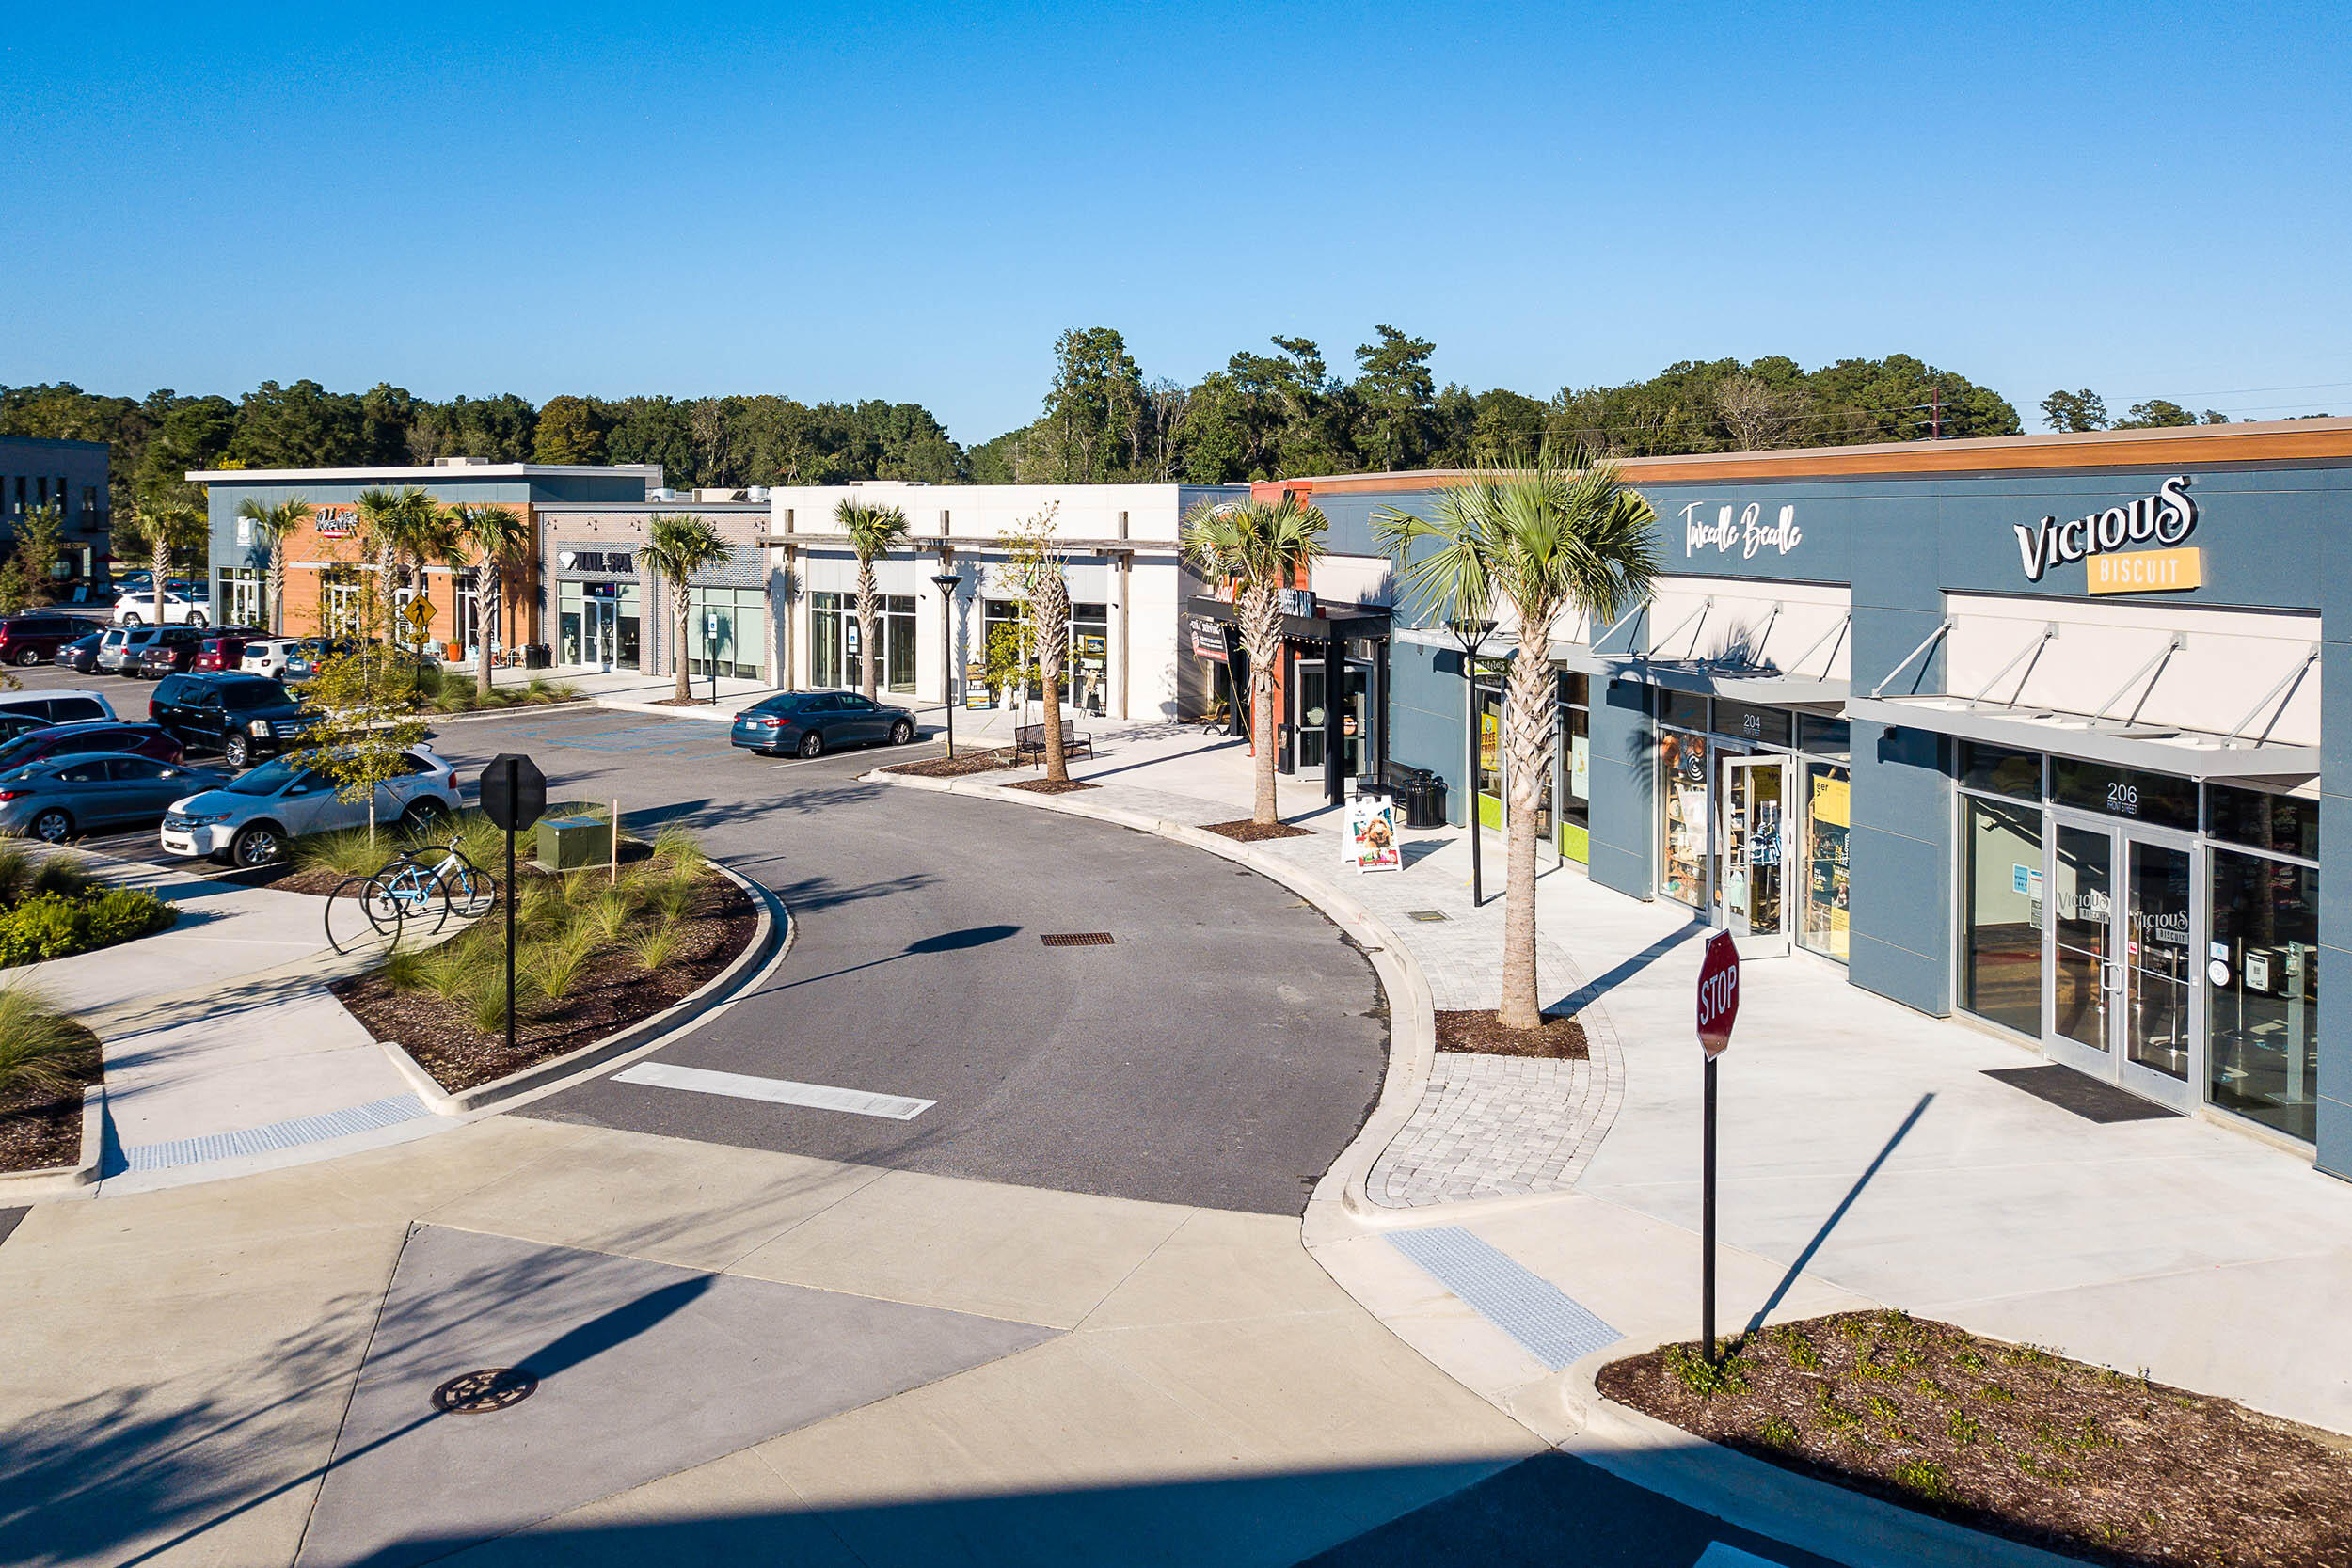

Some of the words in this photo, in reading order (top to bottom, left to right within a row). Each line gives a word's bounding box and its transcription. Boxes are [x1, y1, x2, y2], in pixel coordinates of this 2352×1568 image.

[1677, 501, 1740, 558] Tweedle
[1740, 502, 1803, 560] Beedle
[575, 552, 606, 571] NAIL
[608, 553, 634, 573] SPA
[2100, 558, 2180, 585] BISCUIT
[1744, 714, 1761, 728] 204
[1481, 732, 1495, 744] FREE
[1481, 743, 1495, 754] FOOD
[2107, 782, 2137, 803] 206
[2159, 929, 2185, 943] BISCUIT
[1700, 964, 1737, 1025] STOP
